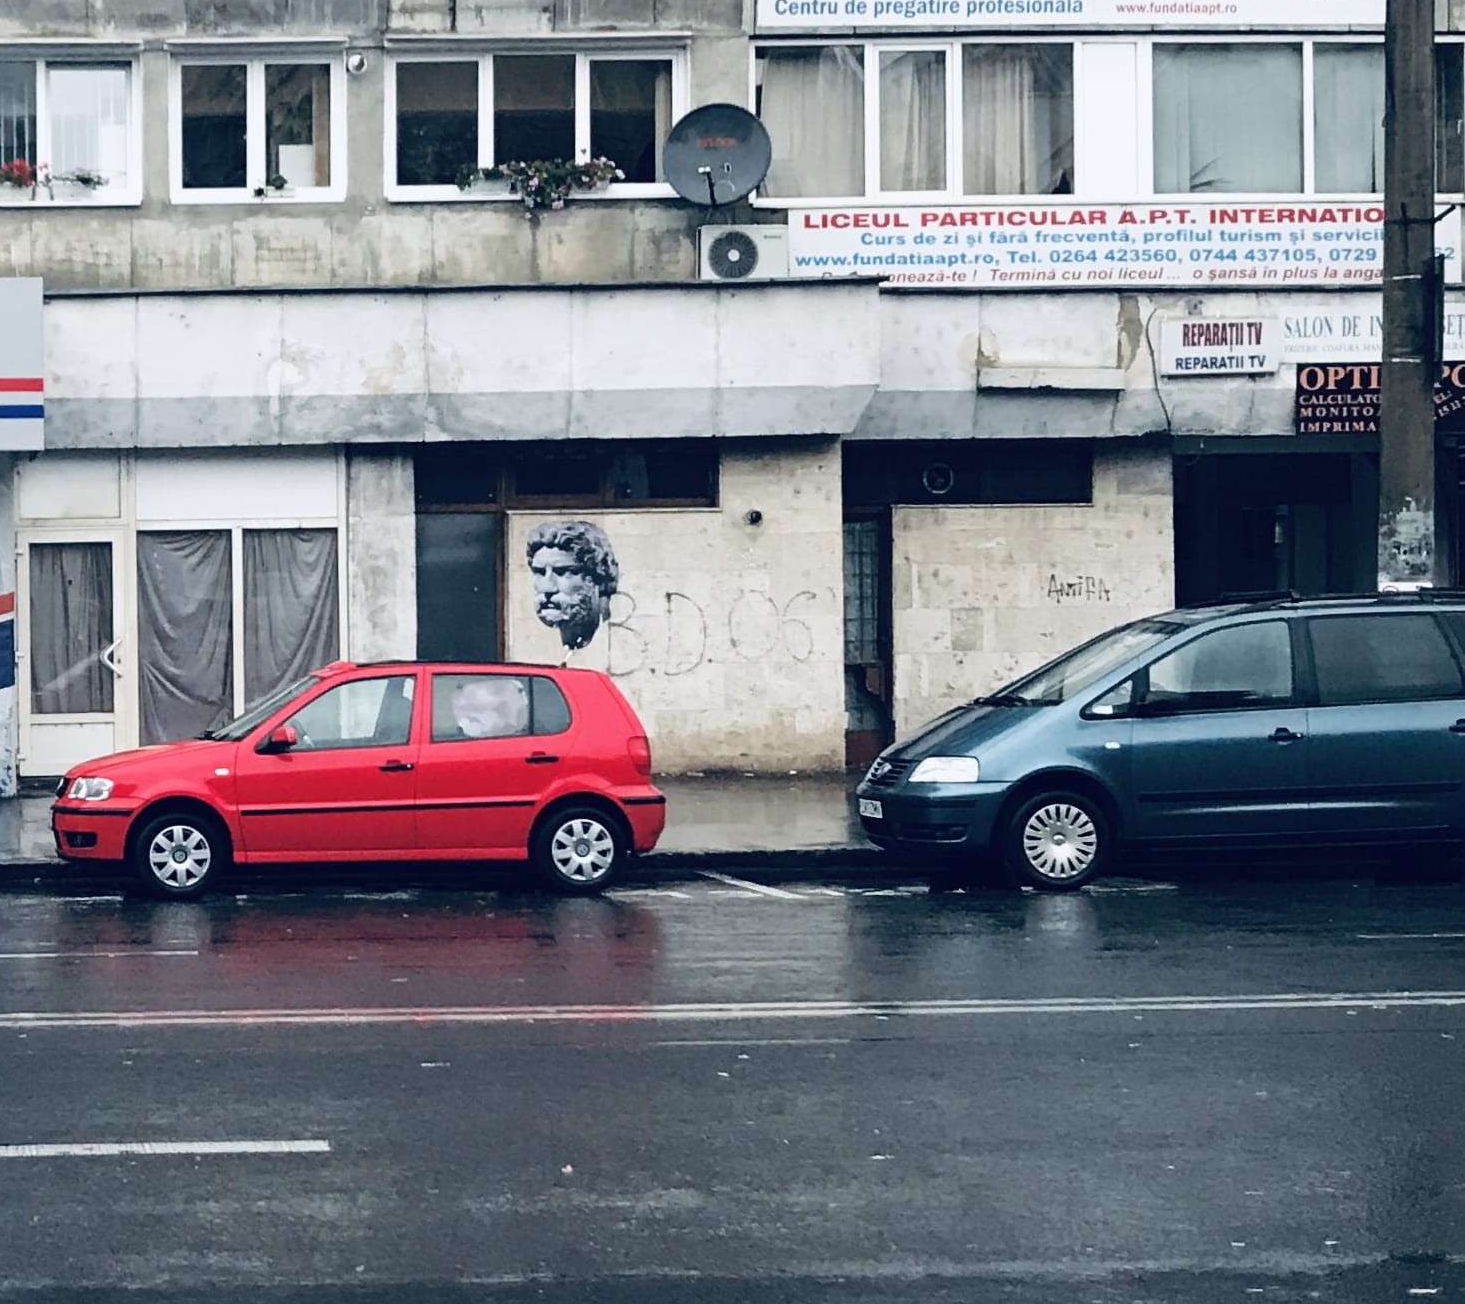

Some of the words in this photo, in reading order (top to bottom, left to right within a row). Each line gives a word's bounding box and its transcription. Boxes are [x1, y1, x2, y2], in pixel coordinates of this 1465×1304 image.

[1116, 2, 1238, 16] www.fundatiaapt.ro
[804, 213, 910, 229] LICEUL
[921, 210, 1108, 228] PARTICULAR
[1118, 208, 1198, 225] A.P.T.
[1209, 207, 1384, 224] INTERNATIO
[860, 232, 906, 246] Curs
[913, 232, 937, 245] de
[943, 231, 959, 245] zi
[989, 230, 1028, 244] fără
[1143, 228, 1212, 244] profilul
[1219, 229, 1282, 242] turism
[795, 250, 1001, 268] www.fundatiaapt.ro,
[1007, 250, 1042, 264] Tel.
[1049, 249, 1097, 263] 0264
[1104, 248, 1183, 264] 423560,
[1189, 248, 1236, 262] 0744
[1243, 247, 1323, 263] 437105,
[1329, 247, 1377, 261] 0729
[990, 268, 1057, 282] Termină
[1061, 271, 1082, 281] cu
[1087, 269, 1115, 281] noi
[1118, 267, 1165, 280] liceul
[1193, 269, 1203, 280] o
[1282, 267, 1319, 282] plus
[1323, 266, 1338, 279] la
[1342, 267, 1385, 281] anga
[1247, 321, 1263, 346] TV
[1283, 315, 1333, 339] SALON
[1342, 315, 1361, 338] DE
[1175, 356, 1245, 370] REPARATII
[1249, 355, 1267, 368] TV
[1299, 365, 1382, 391] OPTI
[1299, 394, 1382, 406] CALCULATO
[1300, 406, 1381, 418] MONITO
[1299, 421, 1377, 433] IMPRIMA
